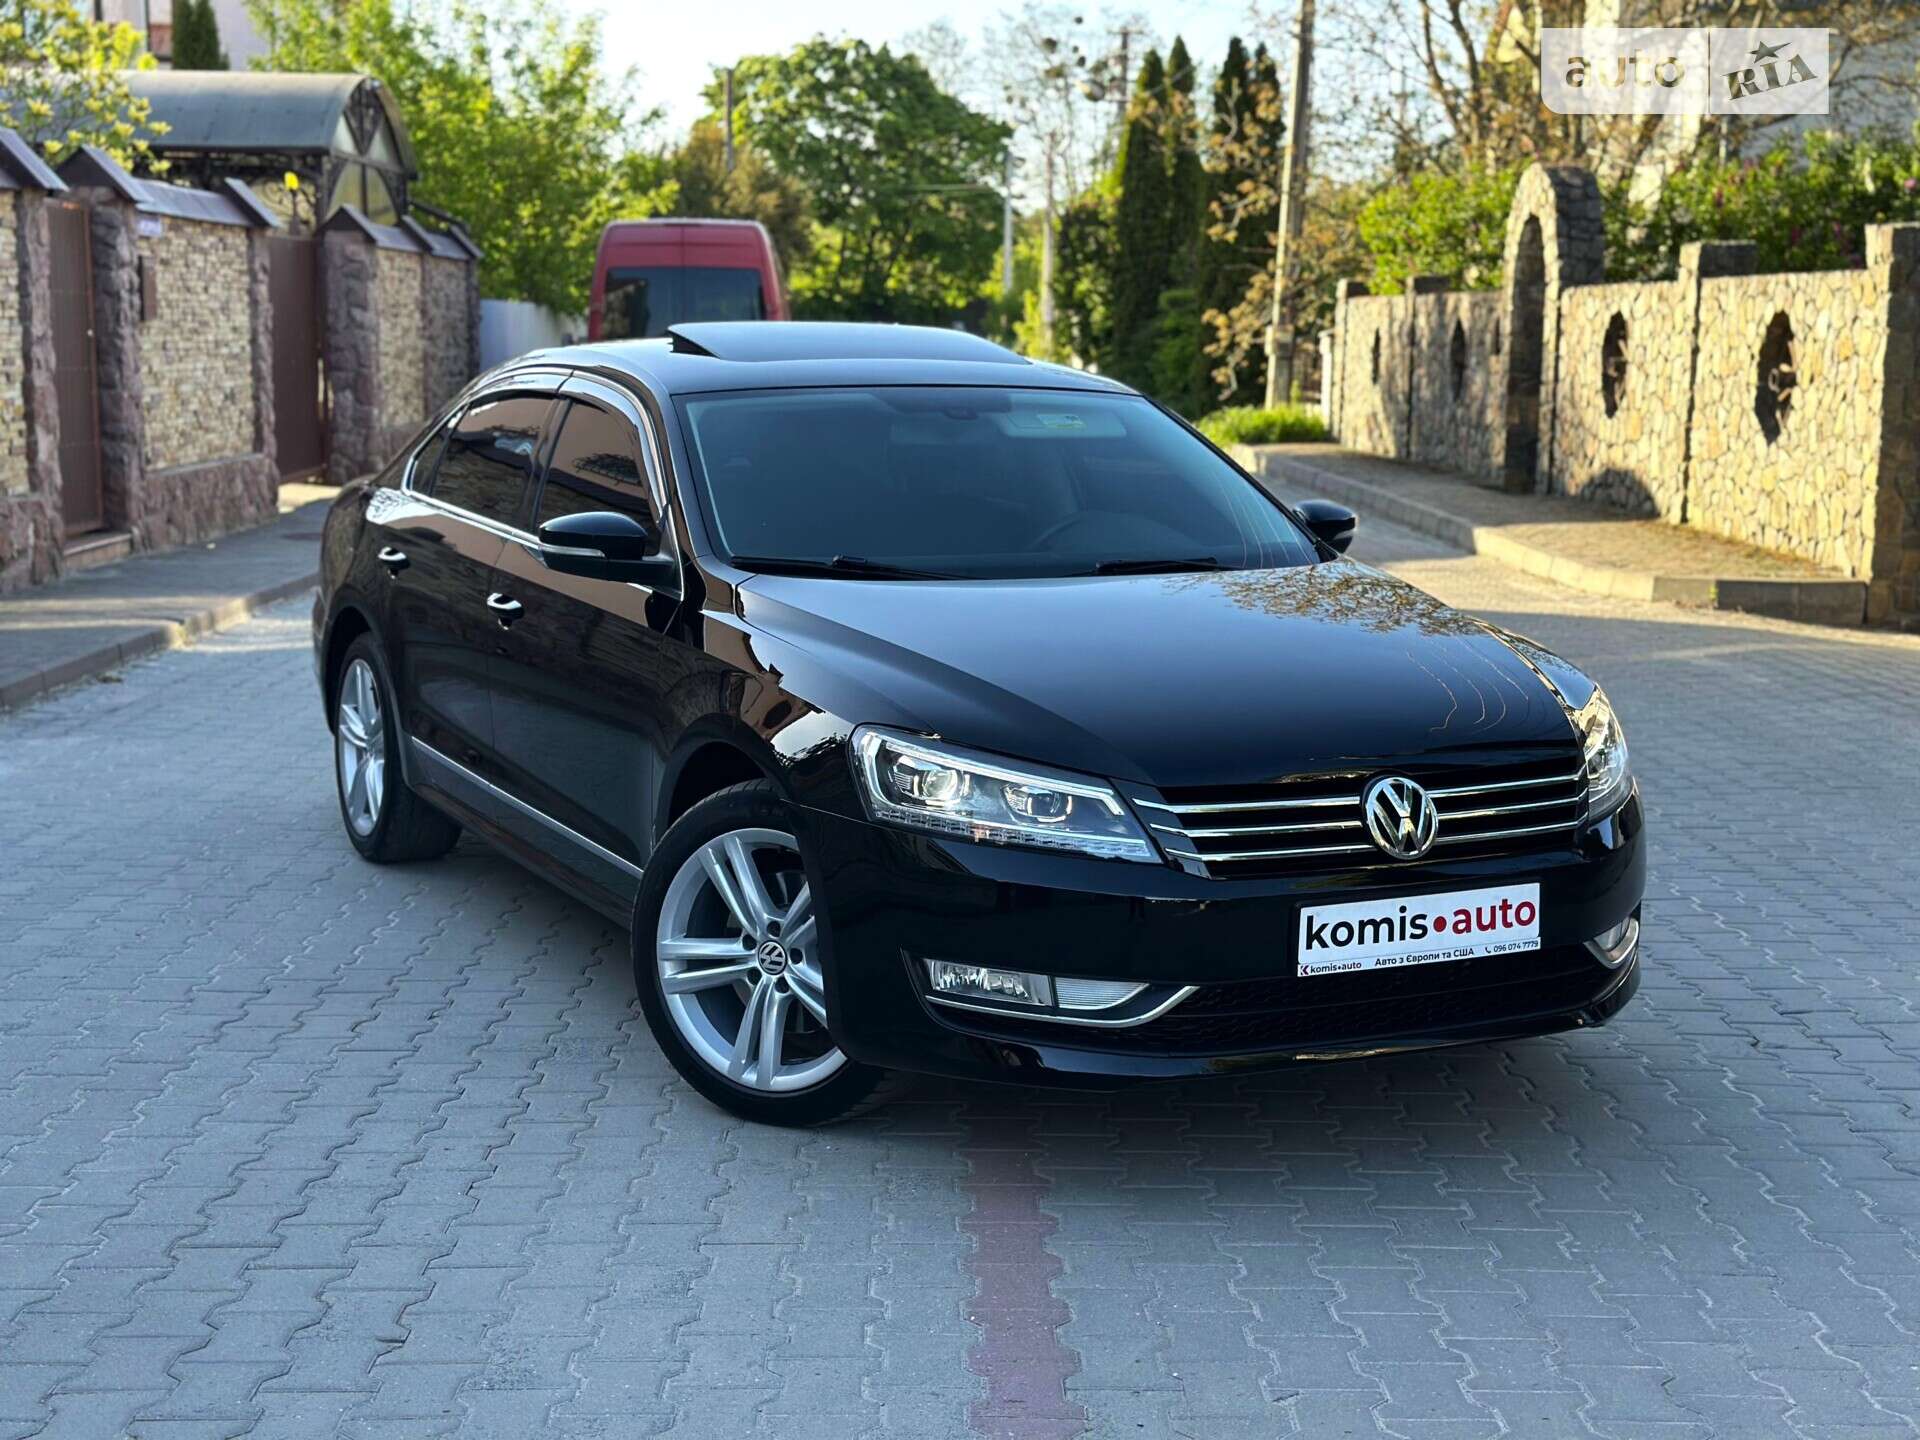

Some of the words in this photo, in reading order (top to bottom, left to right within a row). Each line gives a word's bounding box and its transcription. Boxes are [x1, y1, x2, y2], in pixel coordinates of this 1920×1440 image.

[1493, 944, 1506, 953] 096
[1374, 958, 1397, 967] Авто
[1406, 953, 1440, 965] Європи
[1442, 951, 1452, 959] та
[1453, 947, 1475, 958] США
